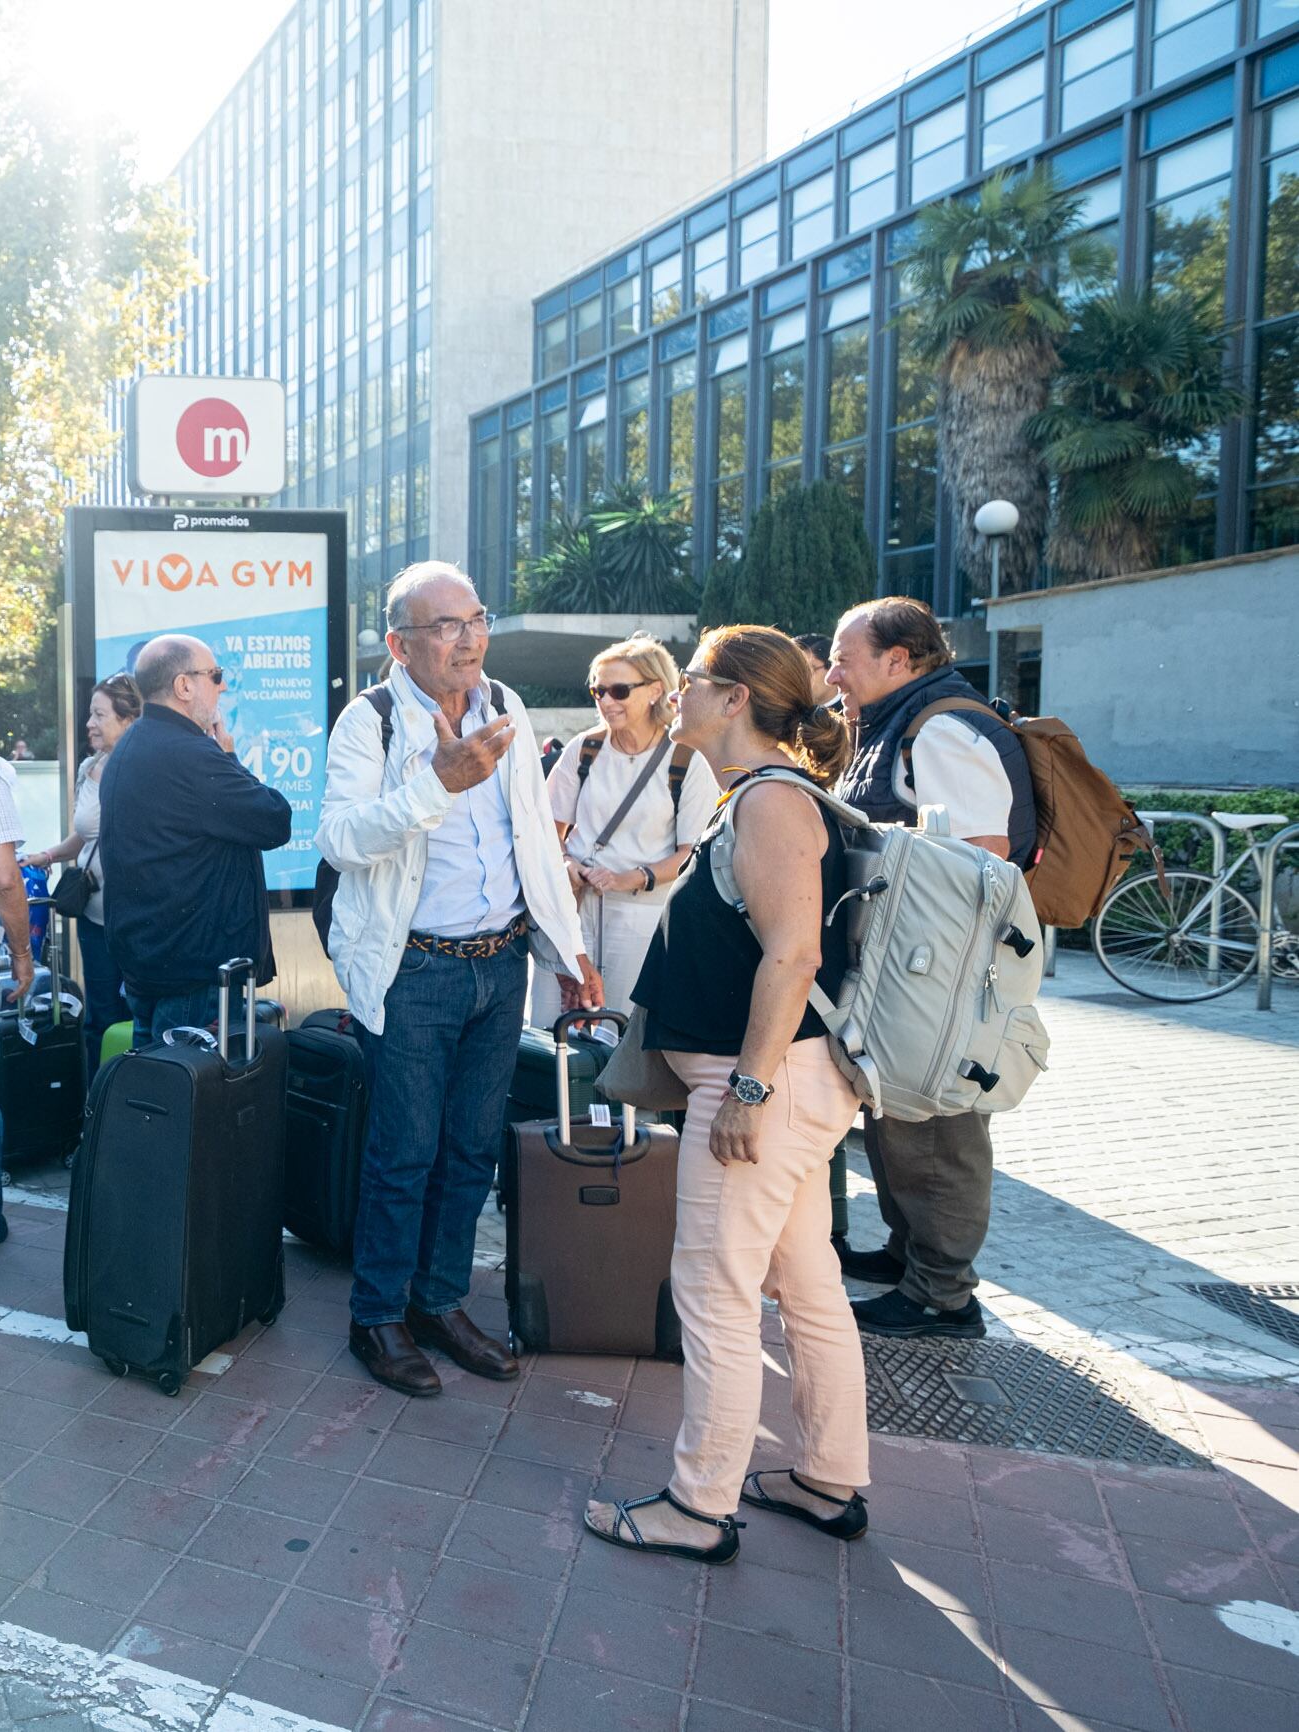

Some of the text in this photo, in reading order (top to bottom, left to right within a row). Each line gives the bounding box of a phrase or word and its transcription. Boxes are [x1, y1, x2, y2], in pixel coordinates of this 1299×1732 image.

[203, 427, 248, 462] m
[190, 514, 250, 528] promedios
[231, 560, 313, 587] GYM
[224, 635, 312, 652] YA ESTAMOS
[243, 653, 312, 669] ABIERTOS
[260, 677, 312, 688] TU NUEVO
[243, 690, 312, 700] VG CLARIANO
